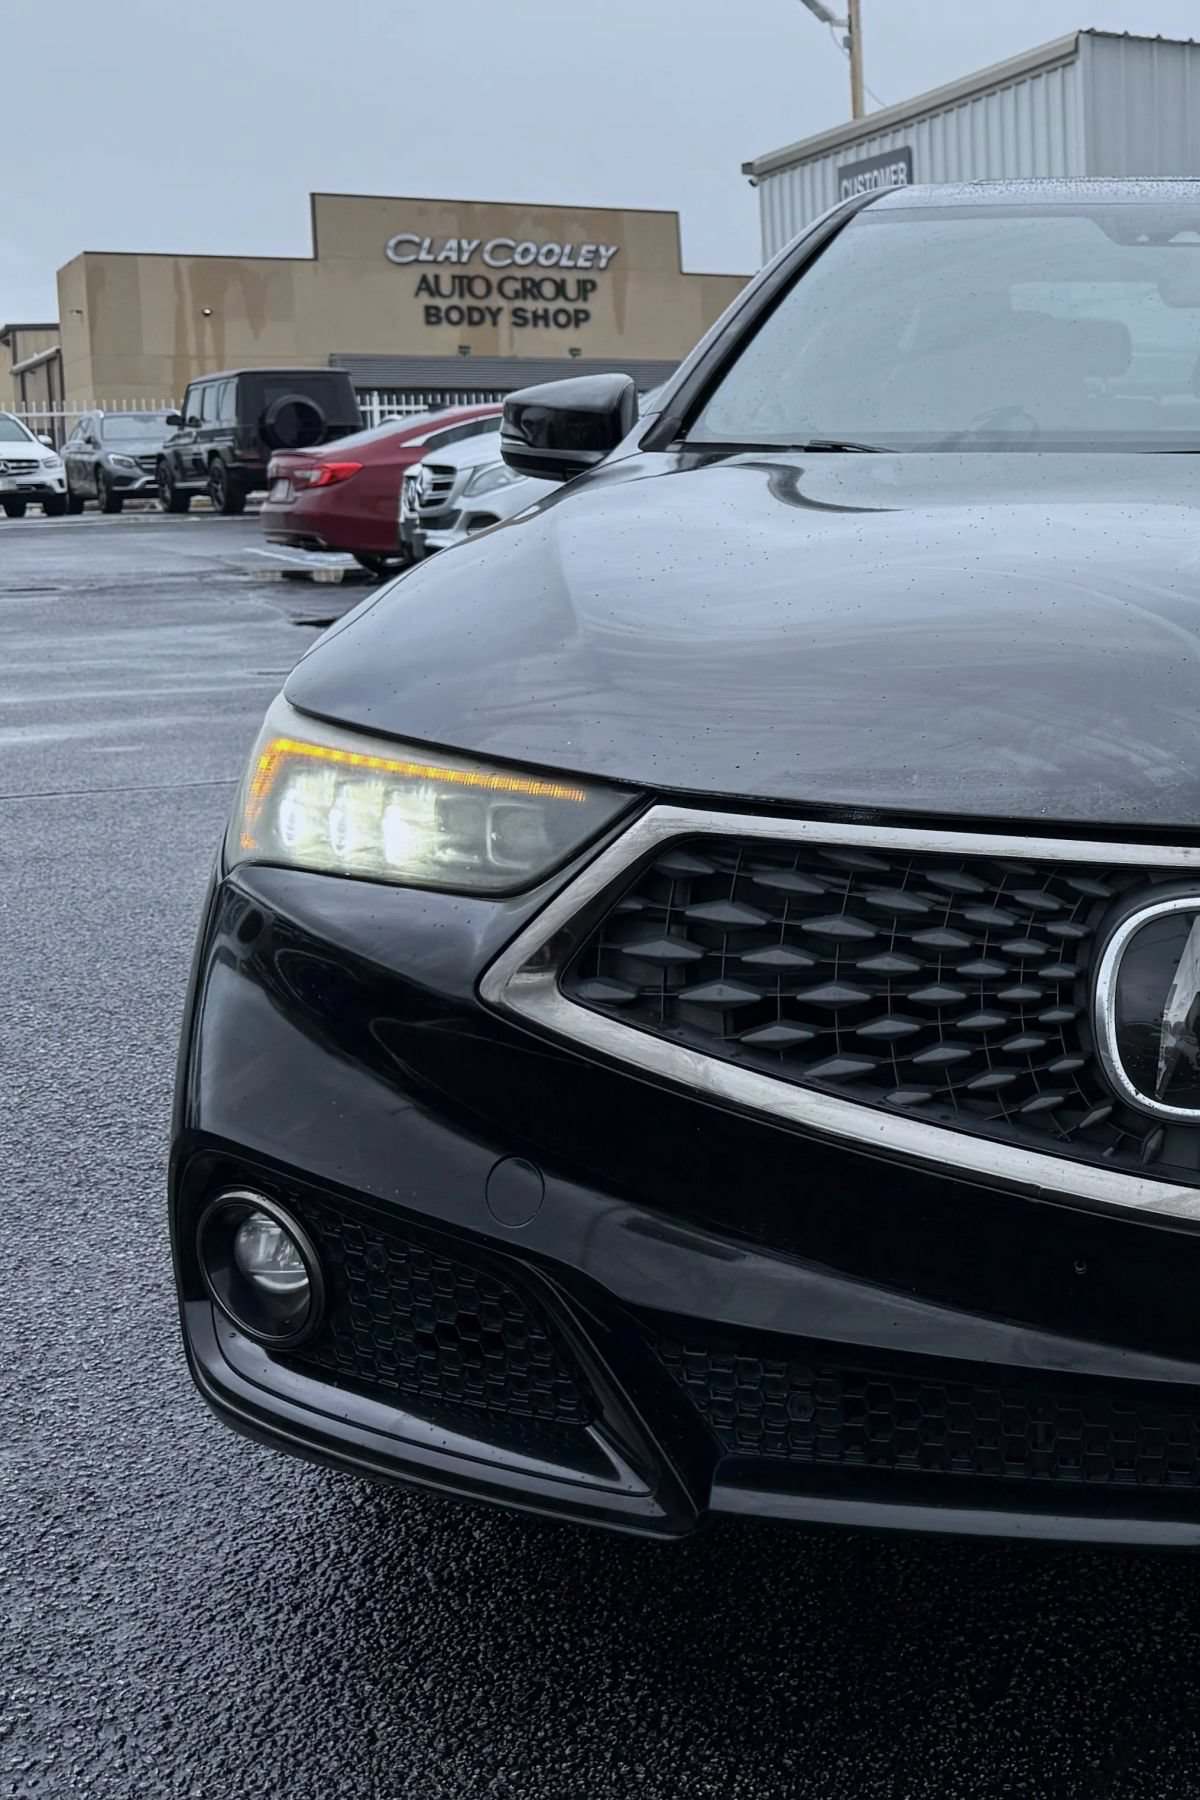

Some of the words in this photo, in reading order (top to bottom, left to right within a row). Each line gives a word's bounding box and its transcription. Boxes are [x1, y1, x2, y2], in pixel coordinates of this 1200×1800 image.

[385, 233, 481, 264] CLAY
[482, 237, 619, 270] COOLEY
[414, 273, 492, 299] AUTO
[497, 275, 598, 302] GROUP
[424, 305, 503, 327] BODY
[511, 307, 591, 329] SHOP
